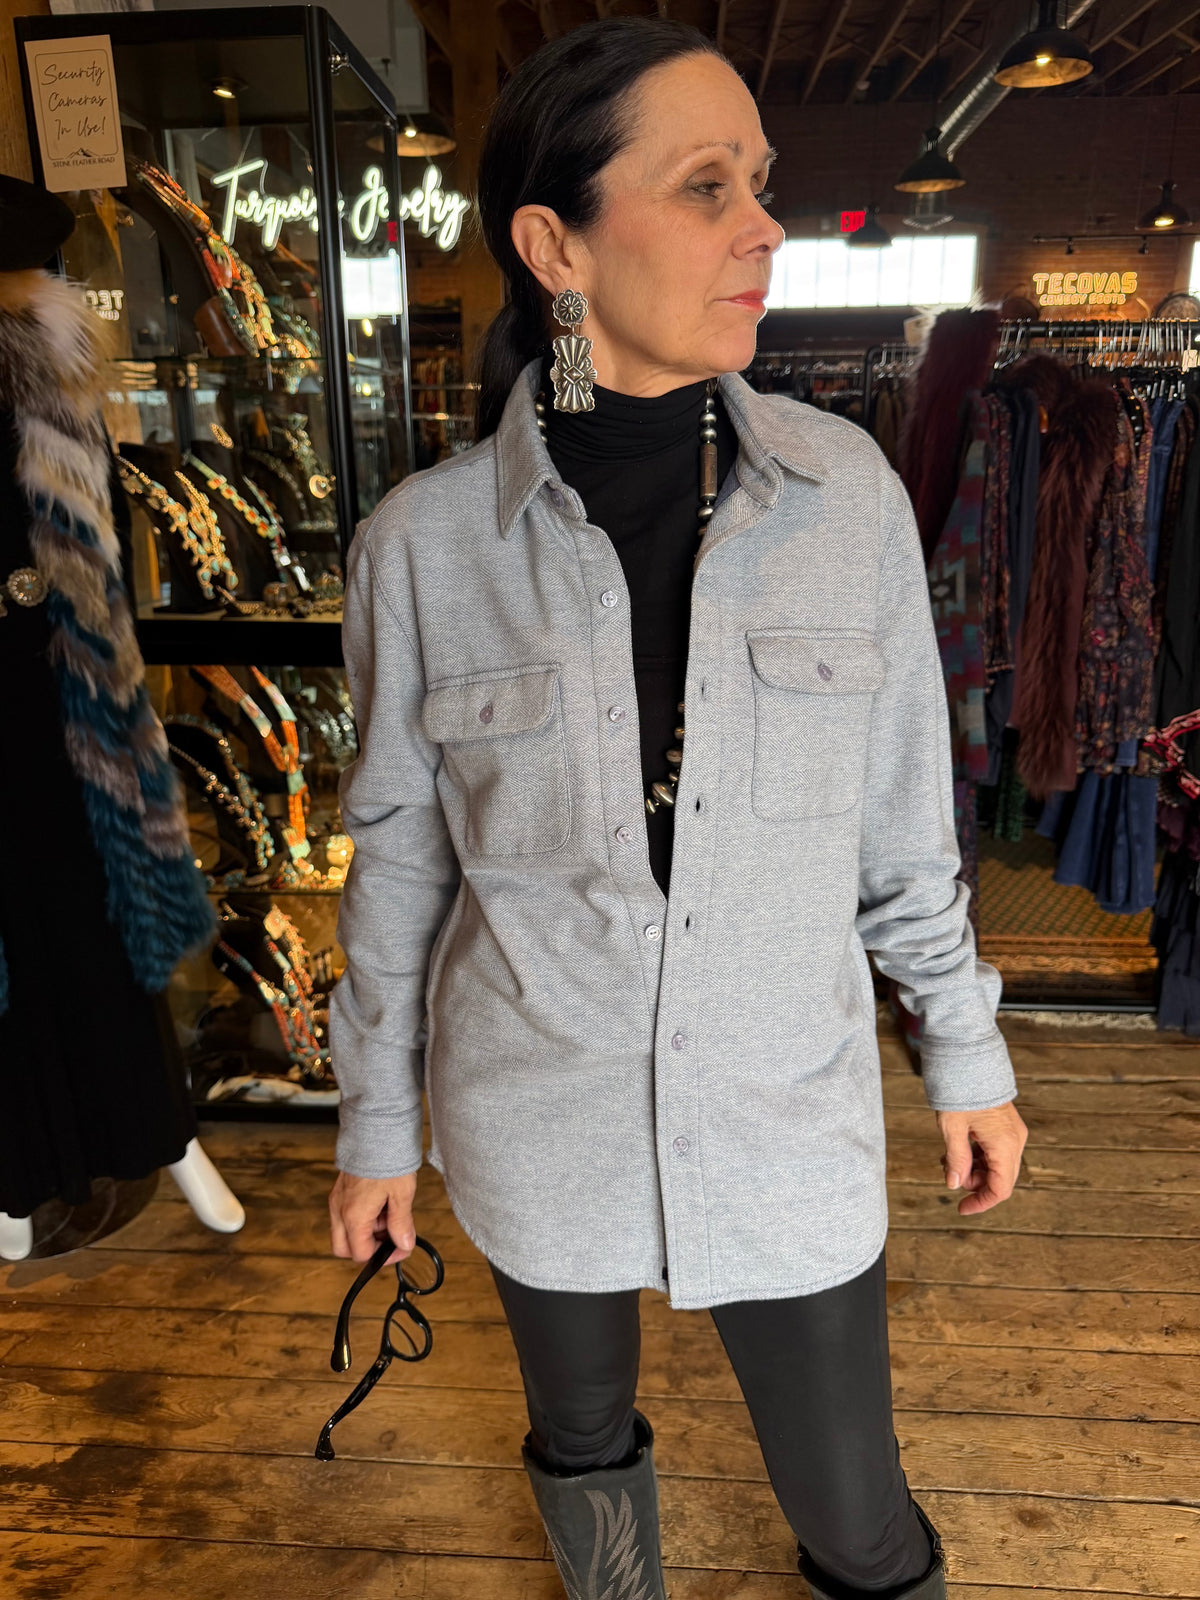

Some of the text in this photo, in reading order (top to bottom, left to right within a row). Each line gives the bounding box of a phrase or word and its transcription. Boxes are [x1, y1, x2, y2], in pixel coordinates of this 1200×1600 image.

[41, 60, 105, 86] Security
[48, 91, 108, 112] Cameras
[55, 116, 106, 141] In Use!
[72, 158, 97, 166] FEATHER
[211, 158, 345, 249] Turquoi
[840, 210, 866, 233] EXIT
[1032, 271, 1138, 295] TECOVAS
[1039, 292, 1127, 306] COWBOY BOOTS
